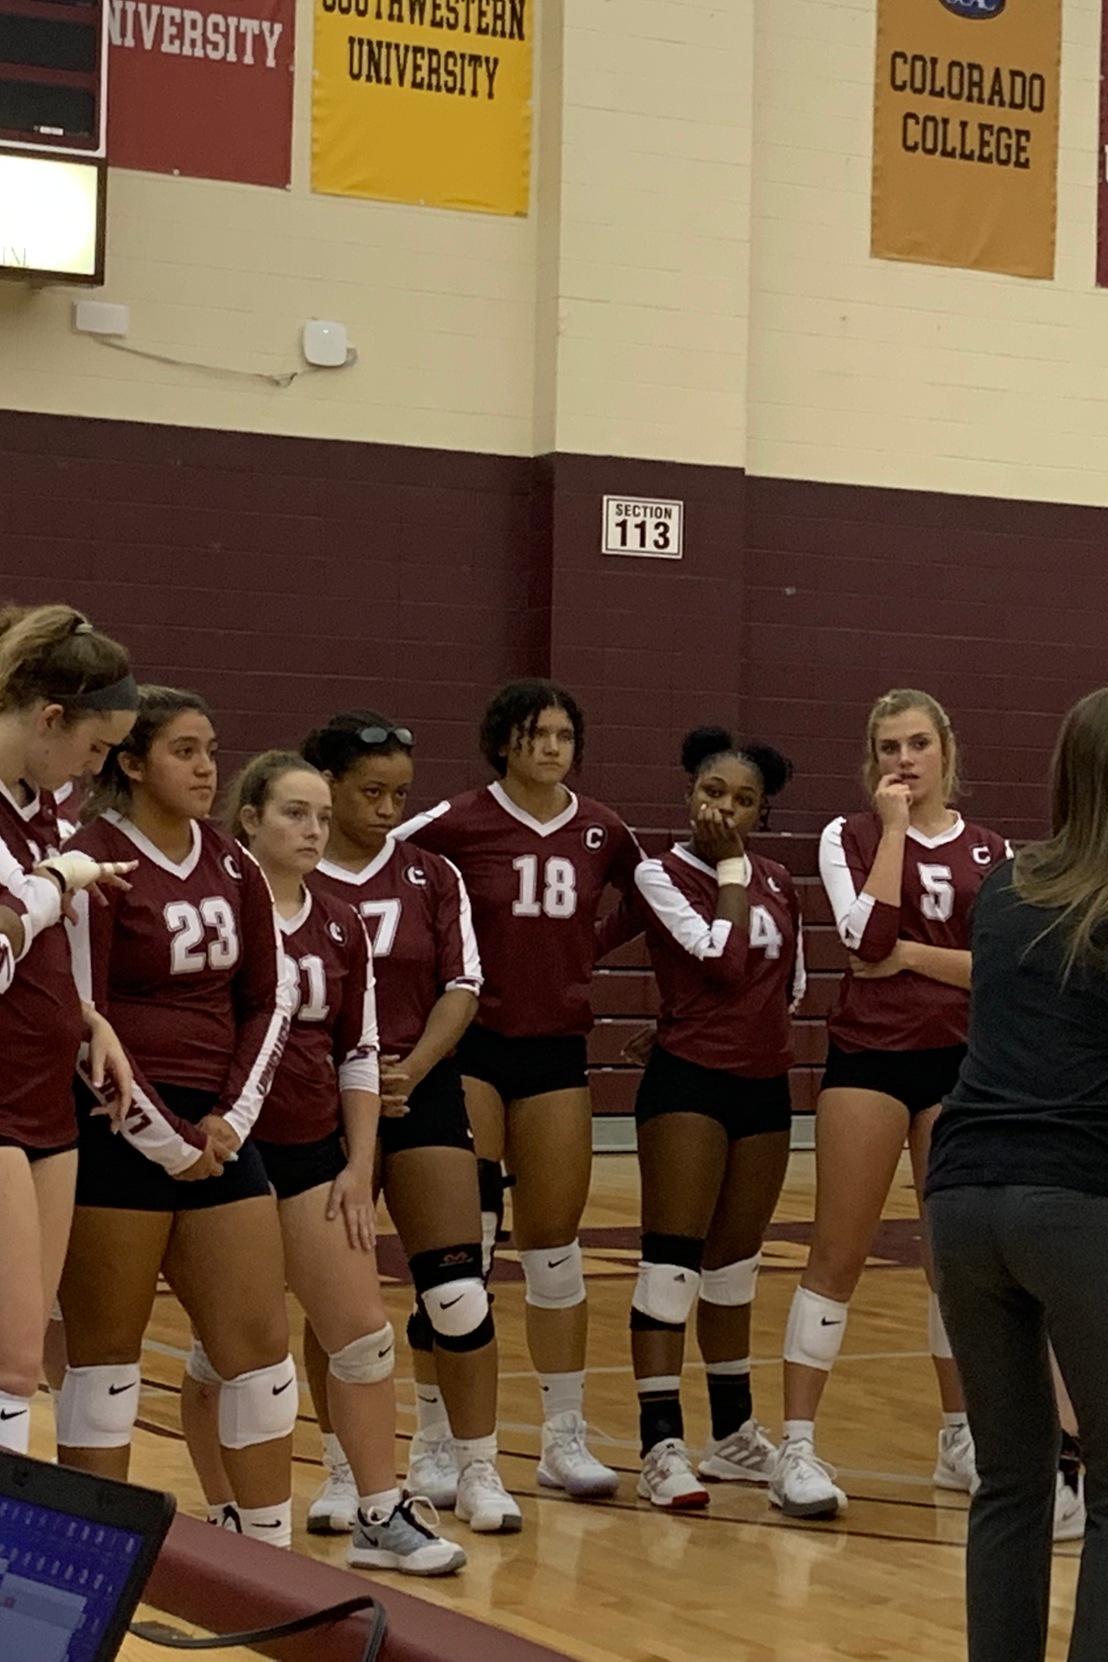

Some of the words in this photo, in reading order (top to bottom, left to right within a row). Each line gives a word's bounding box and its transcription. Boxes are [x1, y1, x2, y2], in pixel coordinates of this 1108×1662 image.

[322, 0, 527, 41] HWESTERN
[347, 35, 499, 100] UNIVERSITY
[890, 51, 1046, 113] COLORADO
[902, 112, 1031, 169] COLLEGE
[615, 503, 672, 519] SECTION
[615, 518, 670, 550] 113
[586, 827, 604, 849] C
[972, 845, 992, 865] C
[407, 865, 427, 886] C
[512, 854, 577, 919] 18
[917, 861, 955, 923] 5
[163, 896, 240, 975] 23
[360, 898, 402, 958] 7
[749, 904, 784, 959] 4
